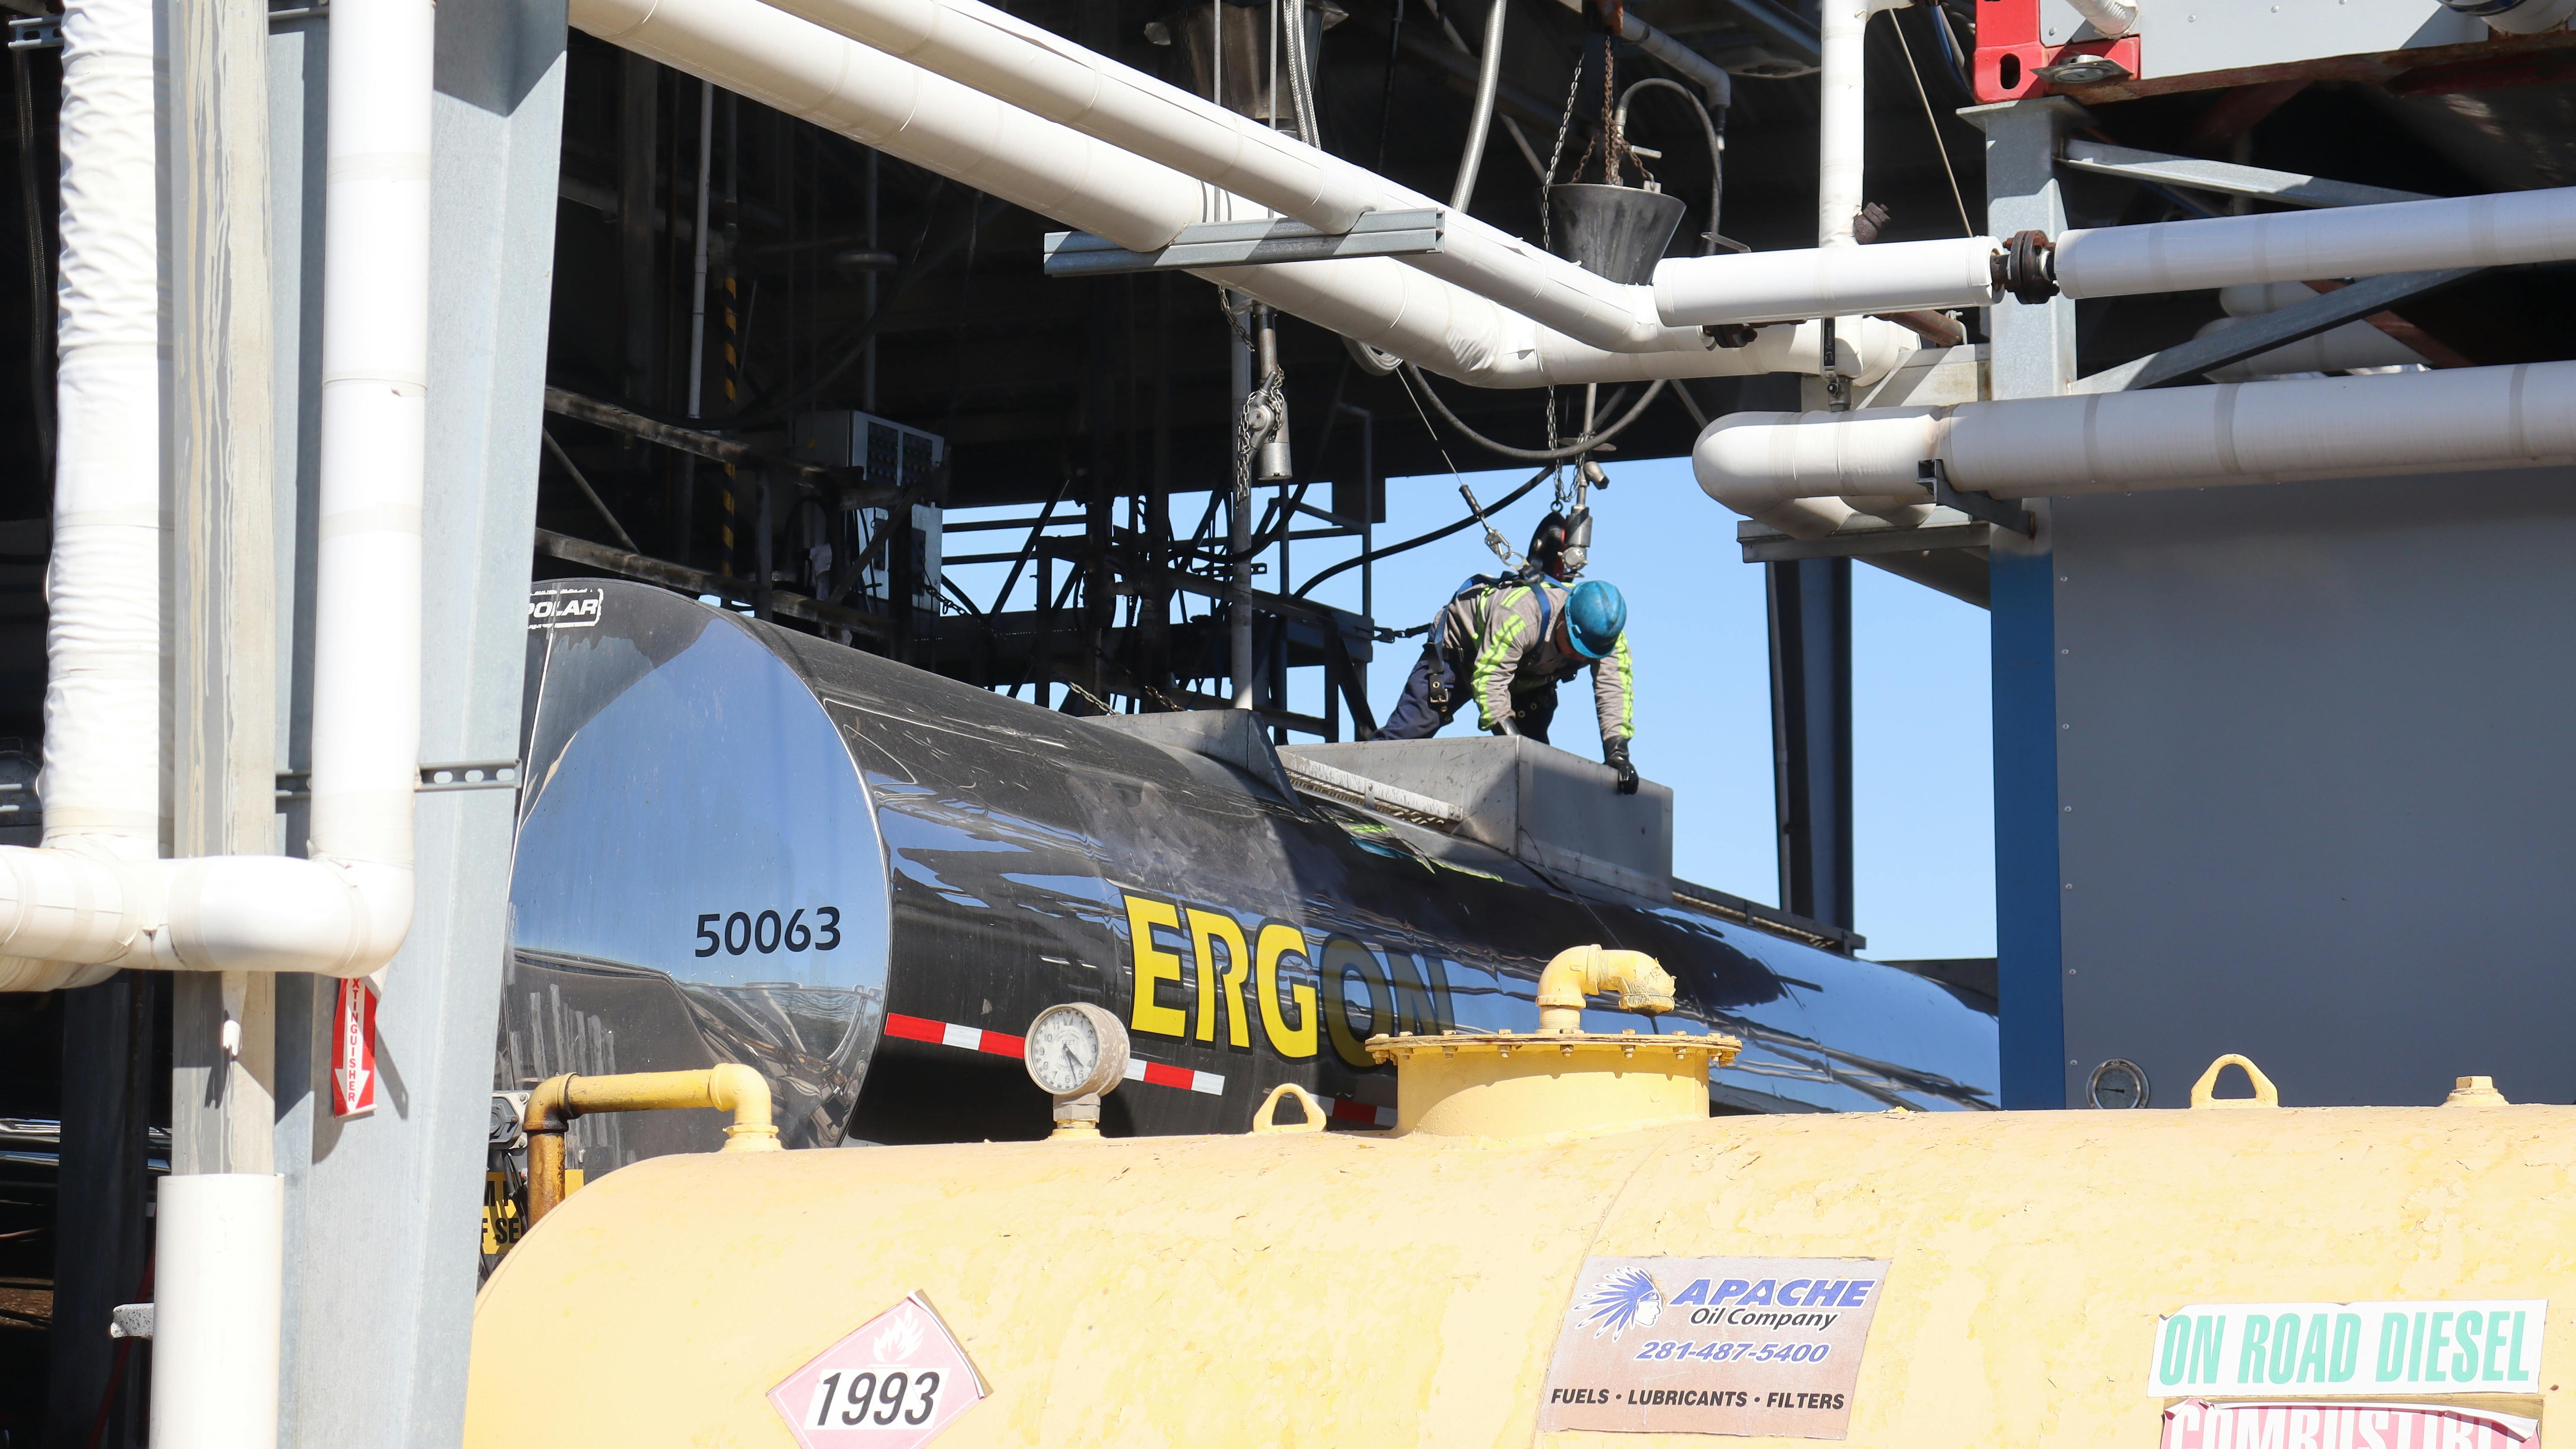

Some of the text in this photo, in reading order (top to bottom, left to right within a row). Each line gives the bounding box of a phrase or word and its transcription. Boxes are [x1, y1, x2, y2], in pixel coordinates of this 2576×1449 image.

[695, 906, 840, 957] 50063
[1121, 892, 1455, 1067] ERGON
[348, 978, 360, 1102] XTINGUISHER
[1088, 1030, 1093, 1038] 2
[1092, 1044, 1097, 1053] 3
[1065, 1075, 1070, 1083] 6
[1078, 1070, 1084, 1078] 5
[1670, 1279, 1876, 1307] APACHE
[1691, 1308, 1837, 1331] Oil Company
[1635, 1342, 1830, 1363] 281-487-5400
[2159, 1310, 2530, 1385] ON ROAD DIESEL
[817, 1371, 940, 1426] 1993
[1551, 1389, 1844, 1409] FUELS LUBRICANTS FILTERS
